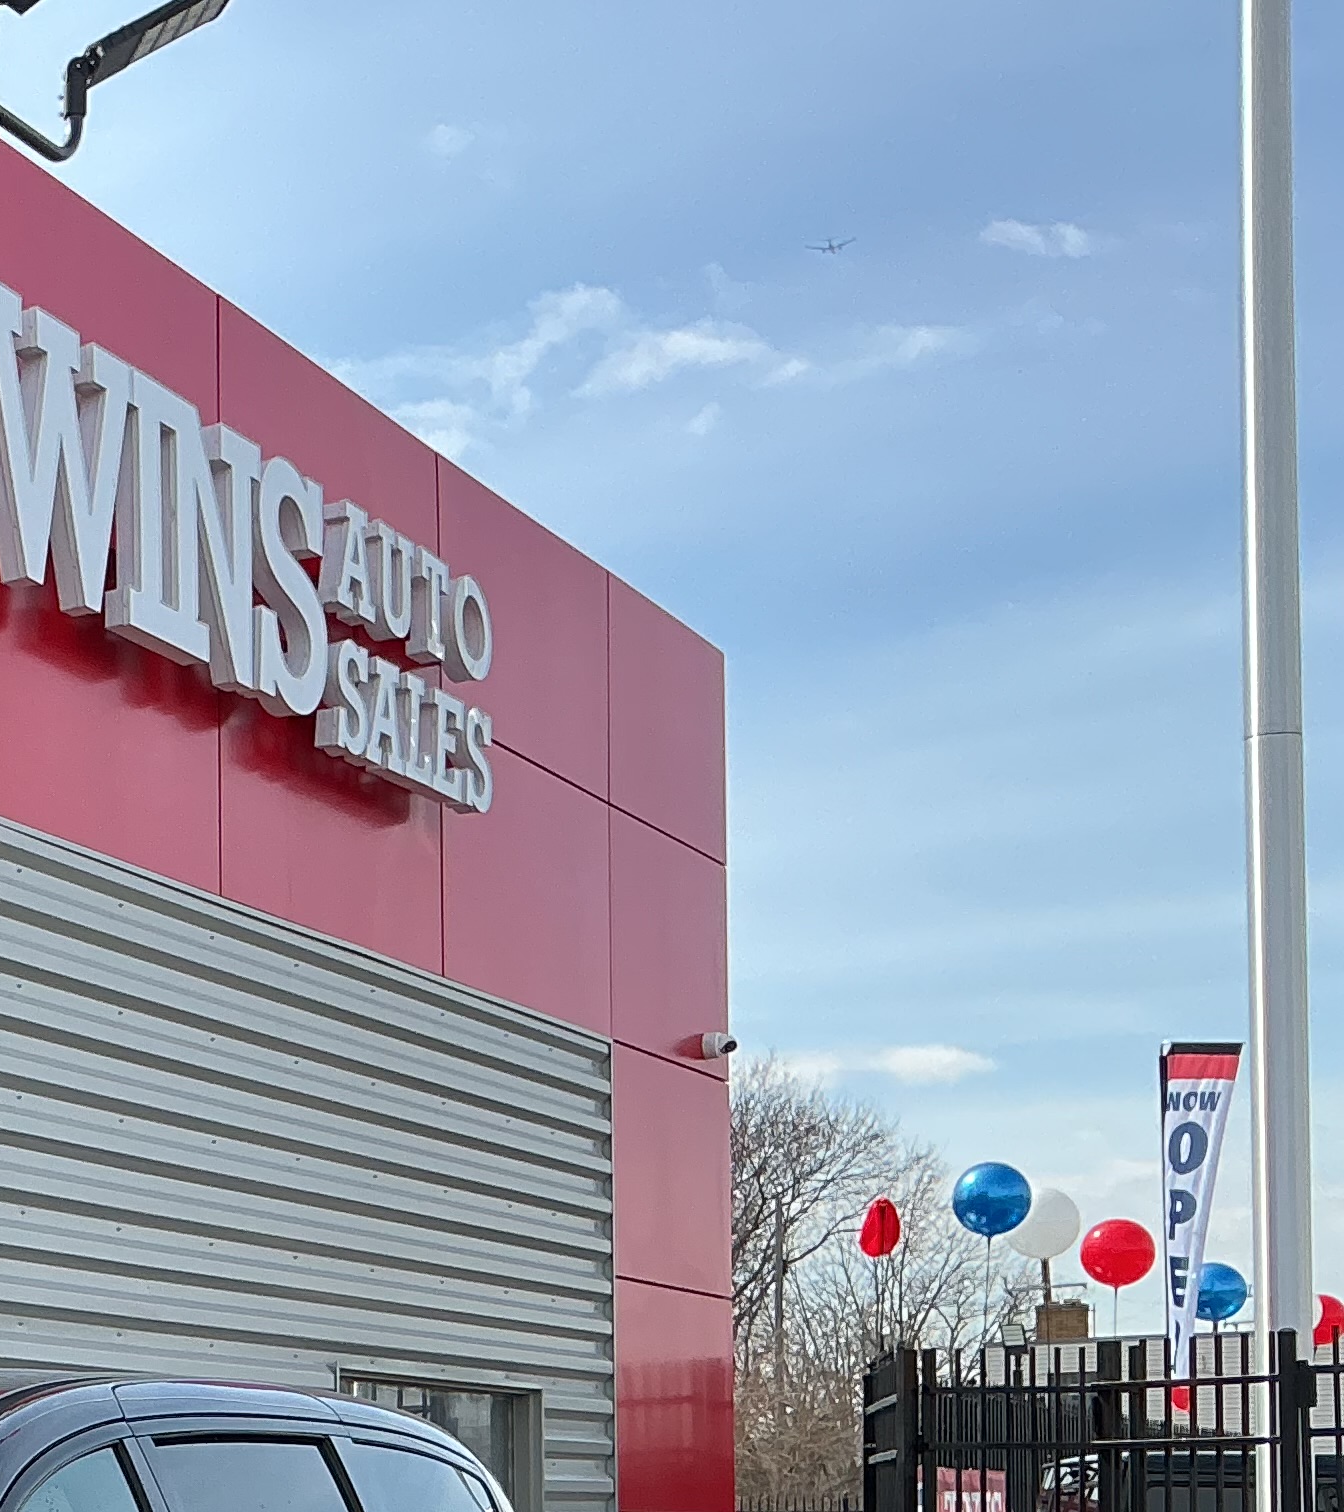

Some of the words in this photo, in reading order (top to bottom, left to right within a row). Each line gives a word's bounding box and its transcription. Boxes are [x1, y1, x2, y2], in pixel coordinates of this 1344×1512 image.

[322, 498, 492, 682] AUTO
[314, 639, 492, 813] SALES
[1164, 1090, 1222, 1112] NOW
[1168, 1120, 1209, 1374] OPE
